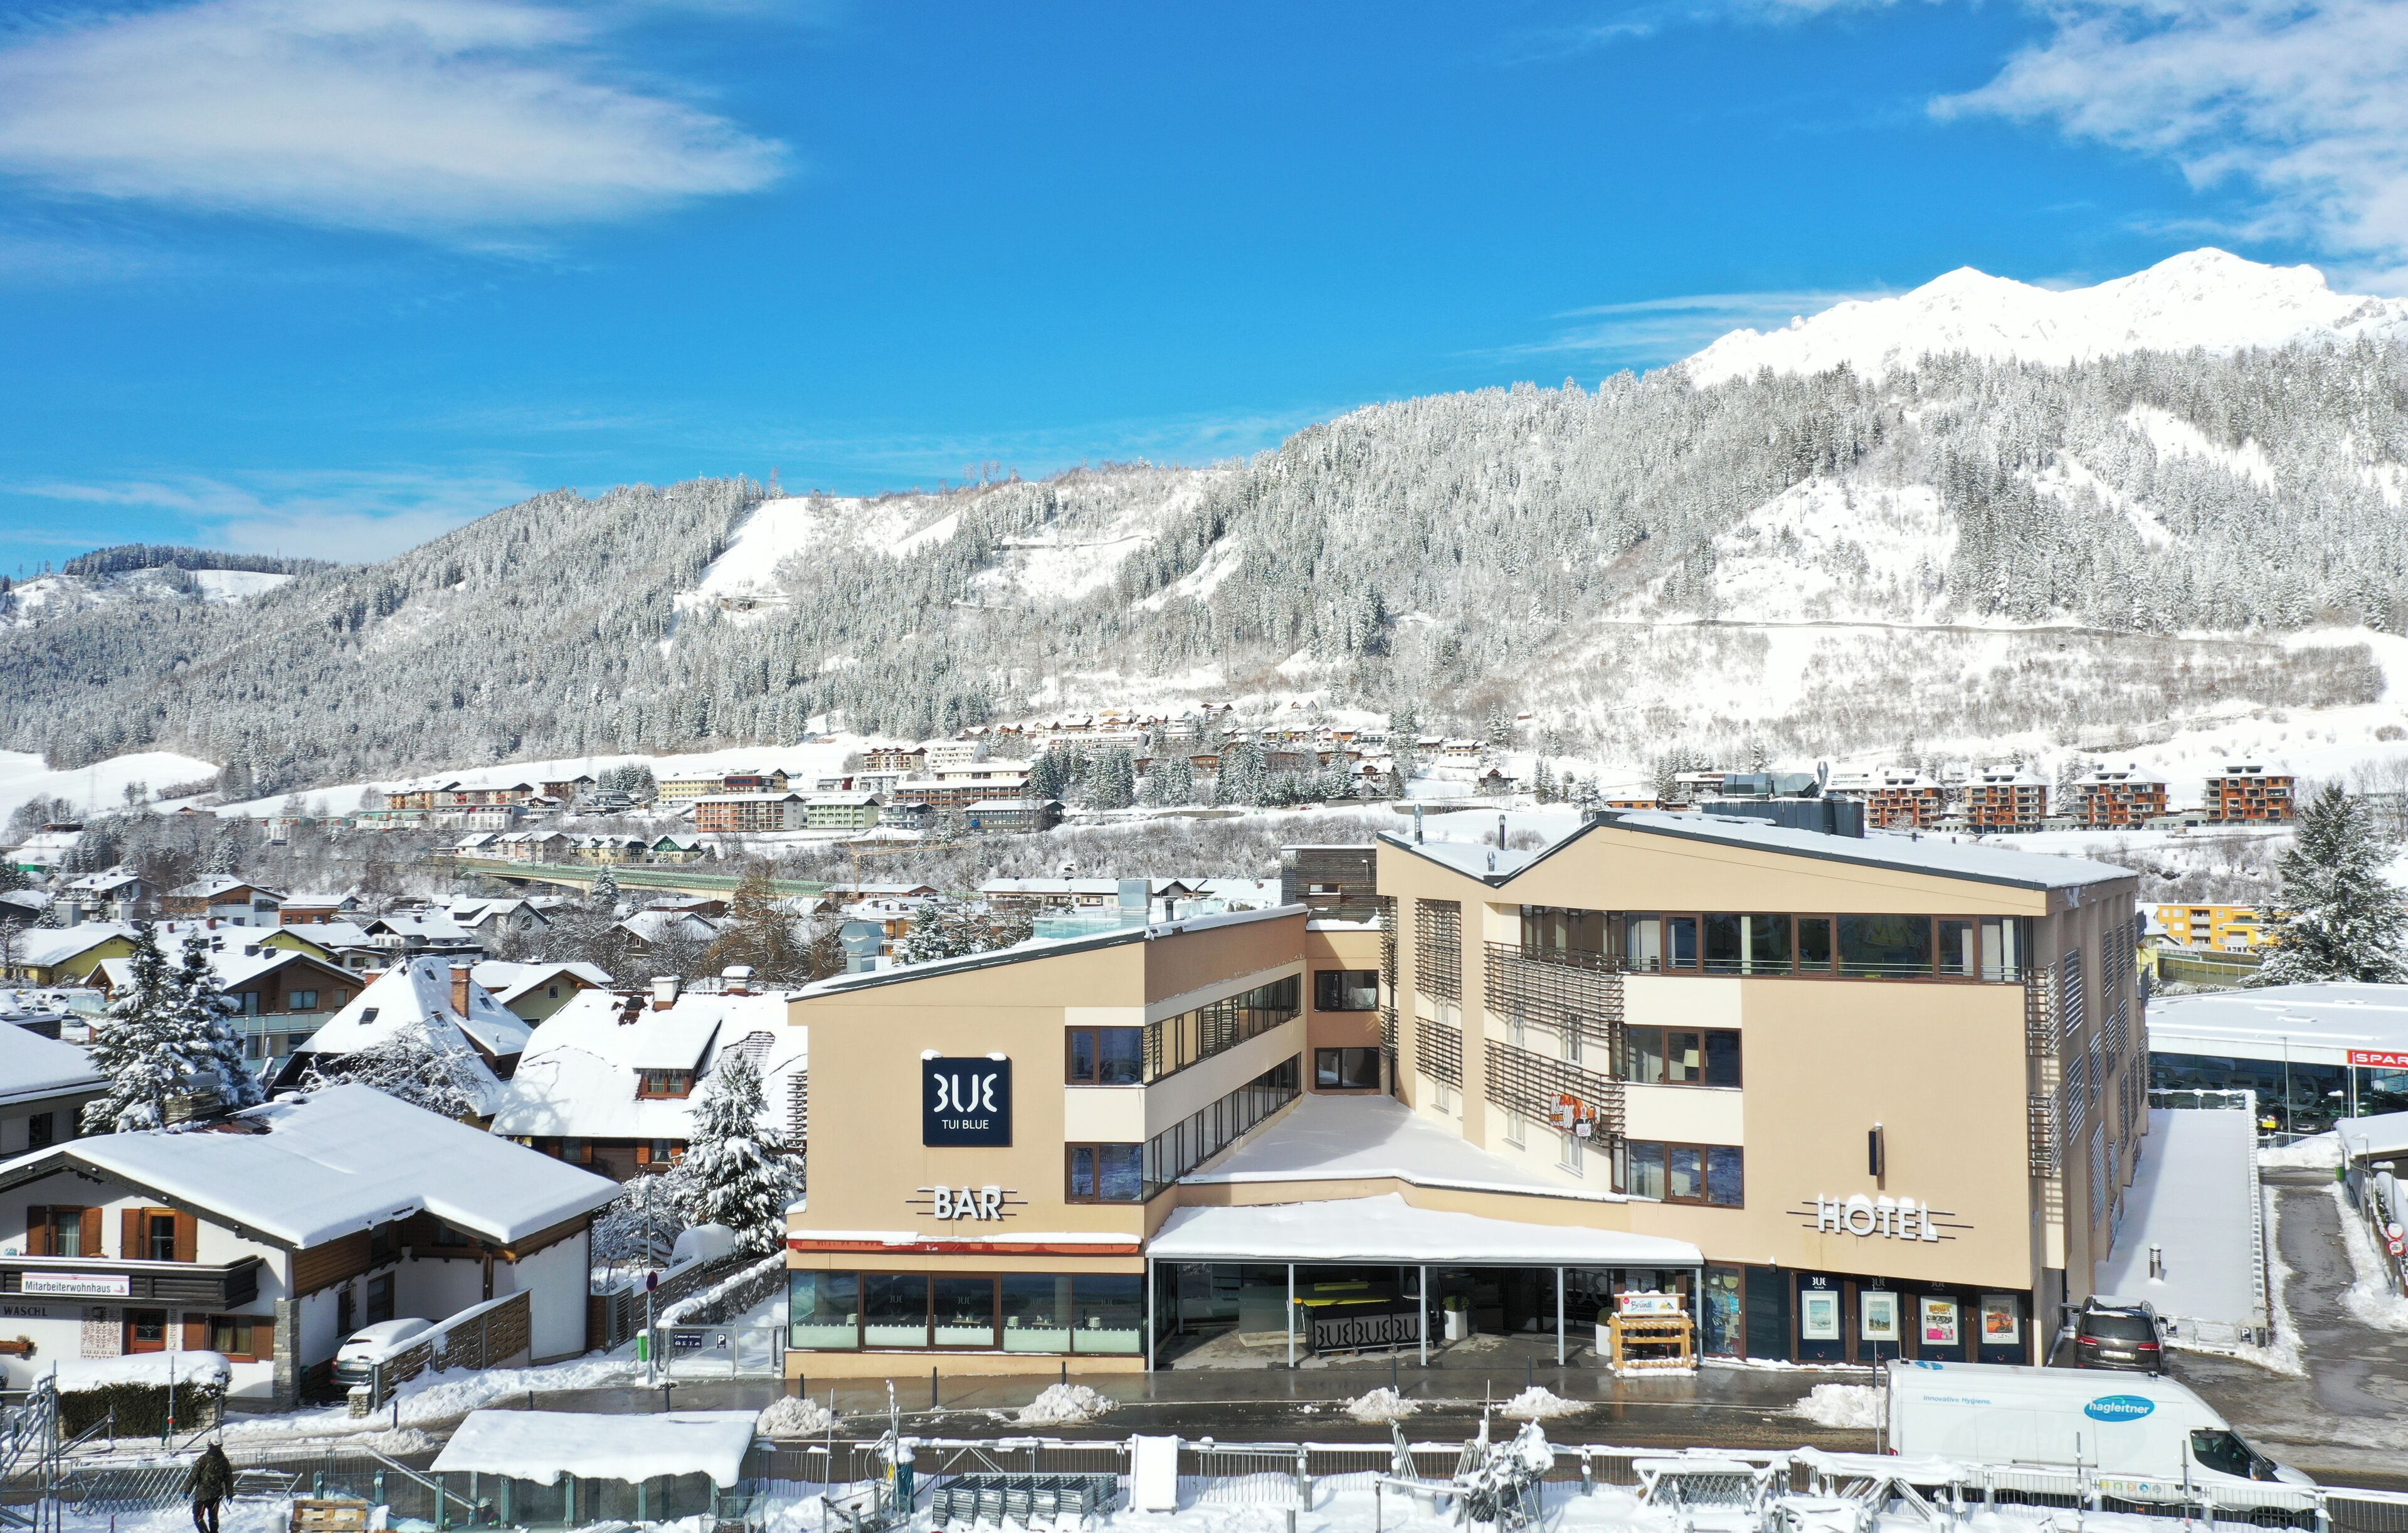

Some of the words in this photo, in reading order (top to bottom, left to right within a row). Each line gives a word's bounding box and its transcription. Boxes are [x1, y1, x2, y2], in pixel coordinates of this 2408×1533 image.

[2355, 1053, 2408, 1065] SPAR
[941, 1120, 959, 1129] TUI
[963, 1120, 989, 1129] BLUE
[934, 1187, 1002, 1219] BAR
[1817, 1199, 1938, 1241] HOTEL
[25, 1281, 111, 1293] Mitarbeiterwohnhaus
[4, 1307, 48, 1317] WASCHL
[2242, 1328, 2250, 1337] P
[718, 1334, 726, 1344] P
[1962, 1397, 1992, 1405] Hygiene.
[2089, 1402, 2150, 1414] hagleitner
